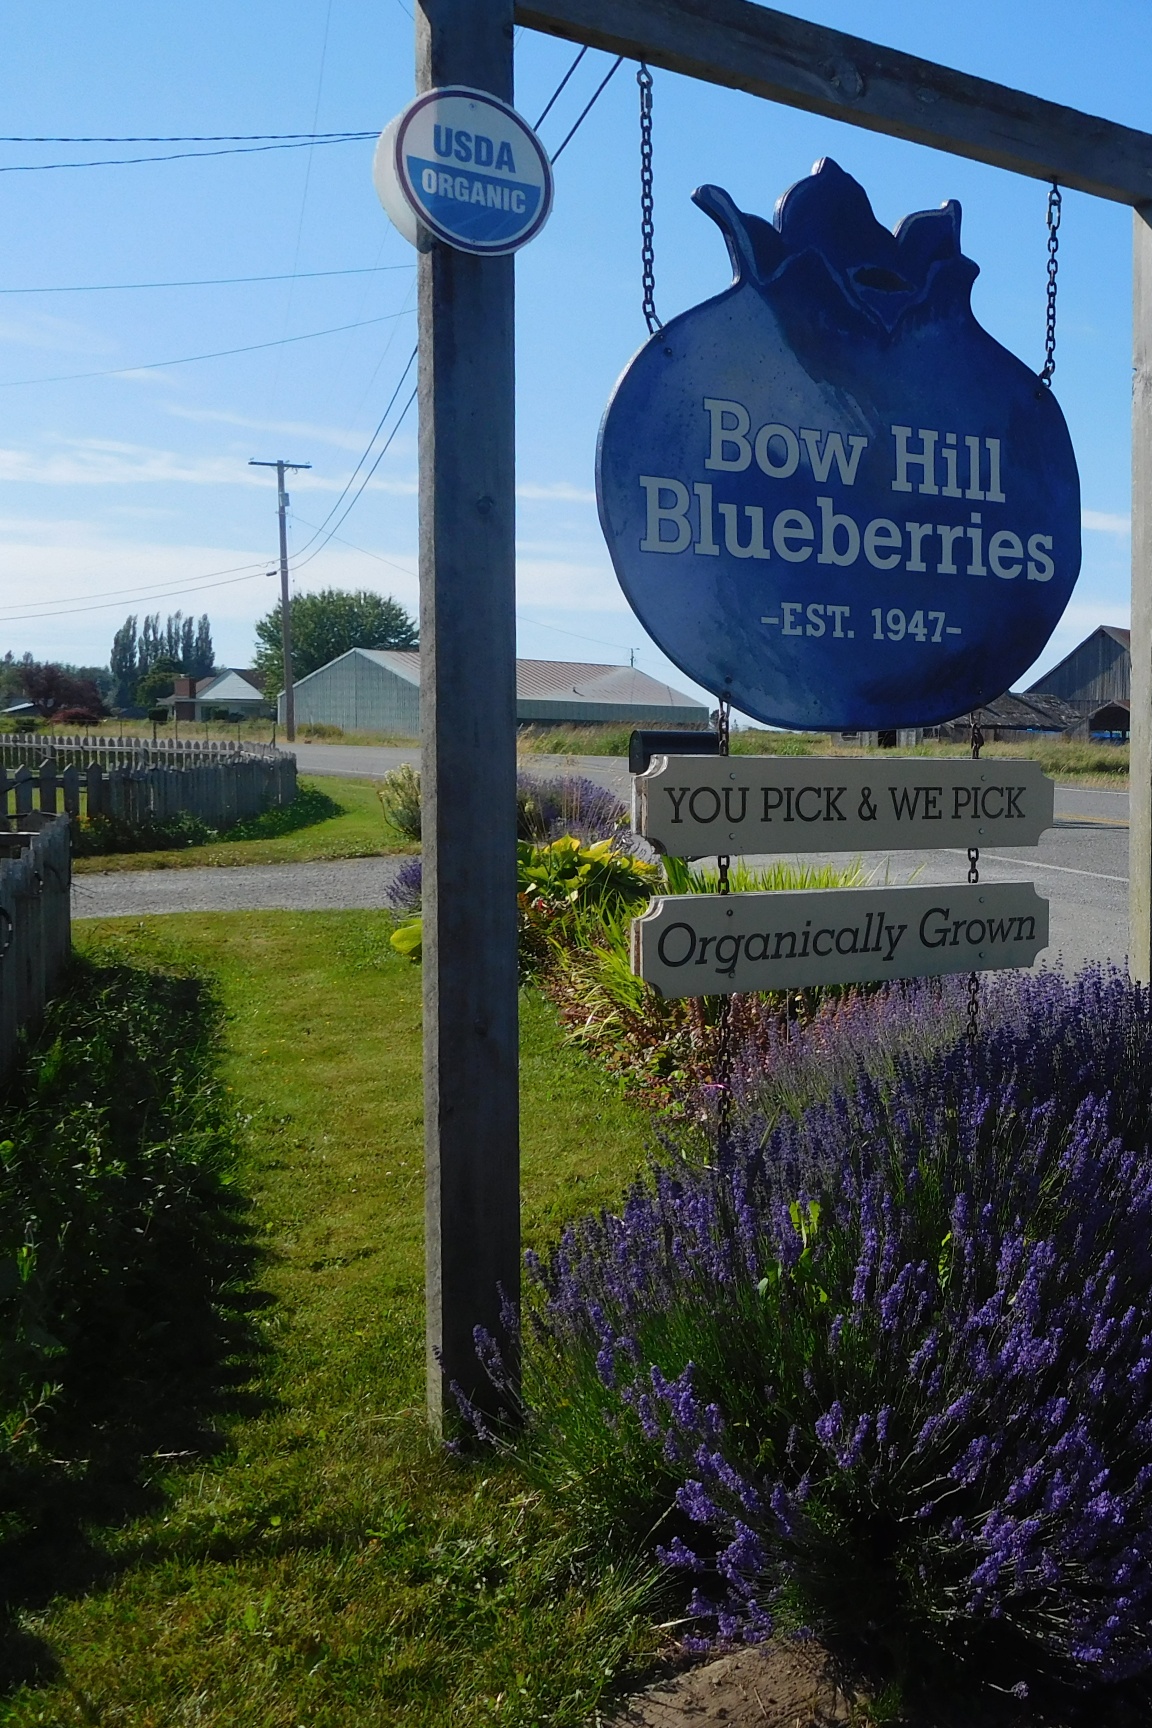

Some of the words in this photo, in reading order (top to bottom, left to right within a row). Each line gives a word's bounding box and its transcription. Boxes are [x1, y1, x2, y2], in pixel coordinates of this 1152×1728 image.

[433, 124, 516, 173] USDA
[421, 168, 526, 214] ORGANIC
[702, 397, 868, 486] Bow
[891, 424, 1006, 503] Hill
[639, 474, 1055, 583] Blueberries
[664, 786, 749, 824] YOU
[761, 786, 847, 822] PICK
[858, 786, 878, 822] &
[888, 786, 943, 820] WE
[951, 786, 1027, 819] PICK
[657, 912, 907, 974] Organically
[919, 907, 1036, 948] Grown
